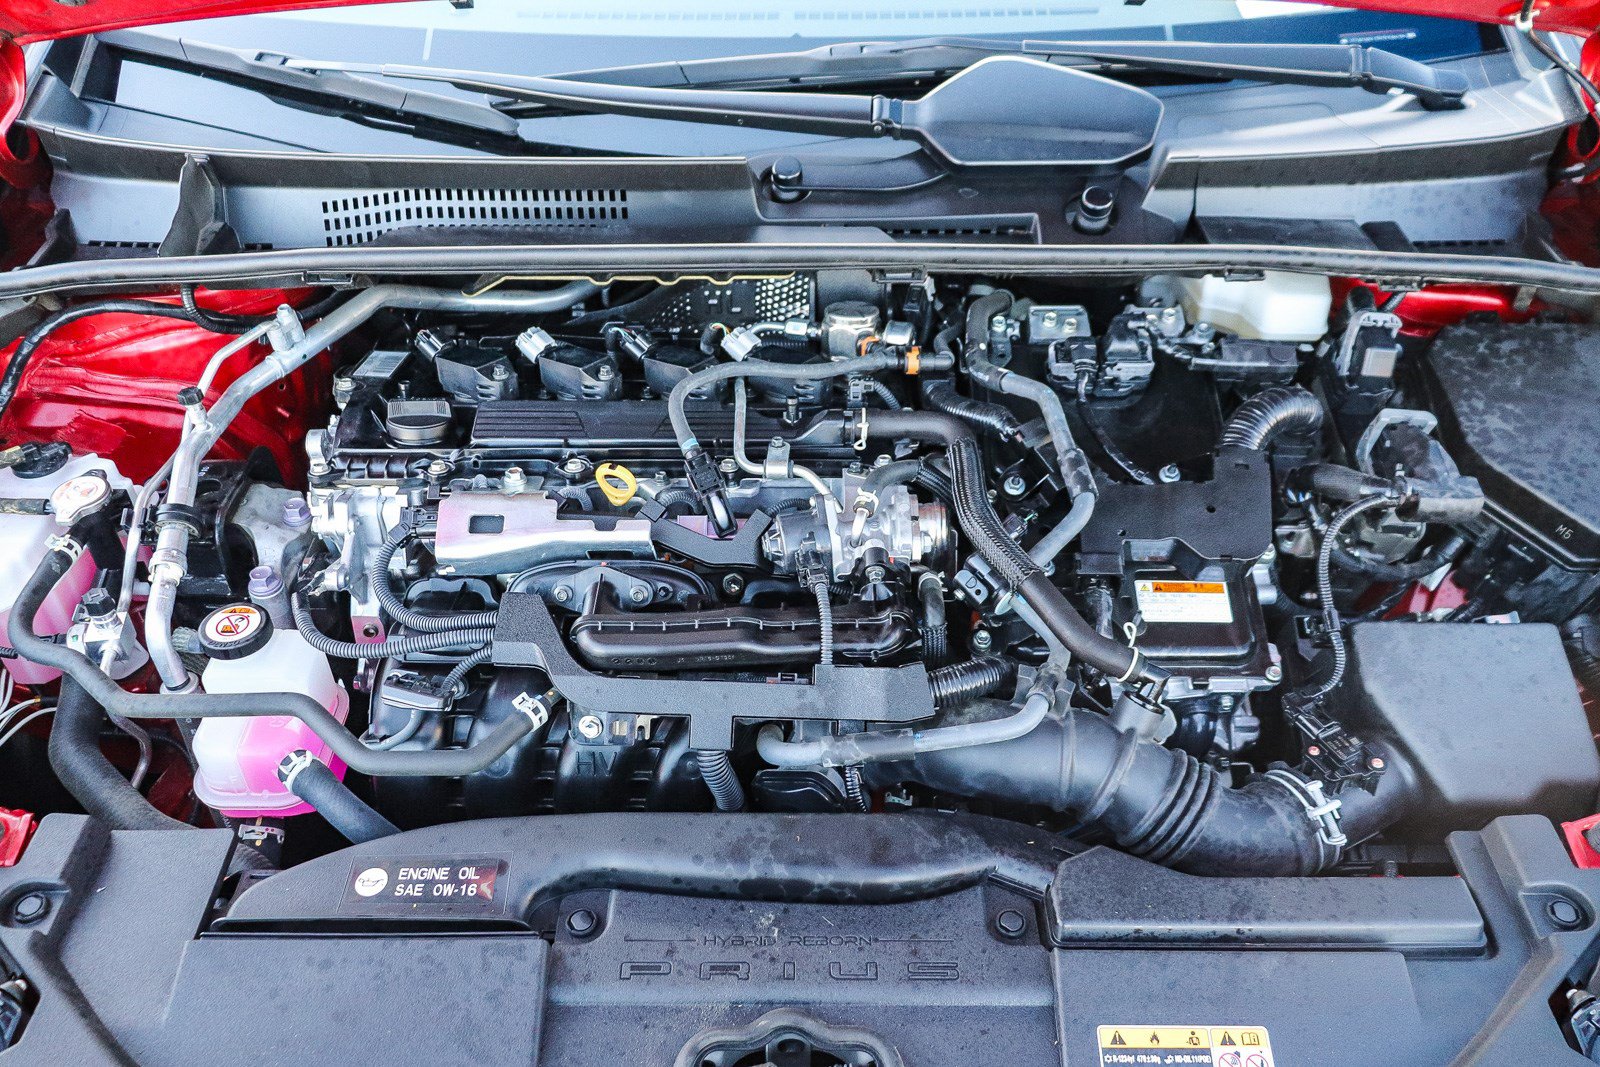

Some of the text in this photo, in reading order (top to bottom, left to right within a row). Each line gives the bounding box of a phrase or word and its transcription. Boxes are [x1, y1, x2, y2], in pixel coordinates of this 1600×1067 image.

[1555, 524, 1574, 539] M5
[576, 751, 618, 777] HV
[398, 867, 480, 880] ENGINE OIL
[394, 884, 477, 896] SAE 0W-16
[703, 935, 873, 947] HYBRID REBORN
[619, 961, 960, 980] PRIUS
